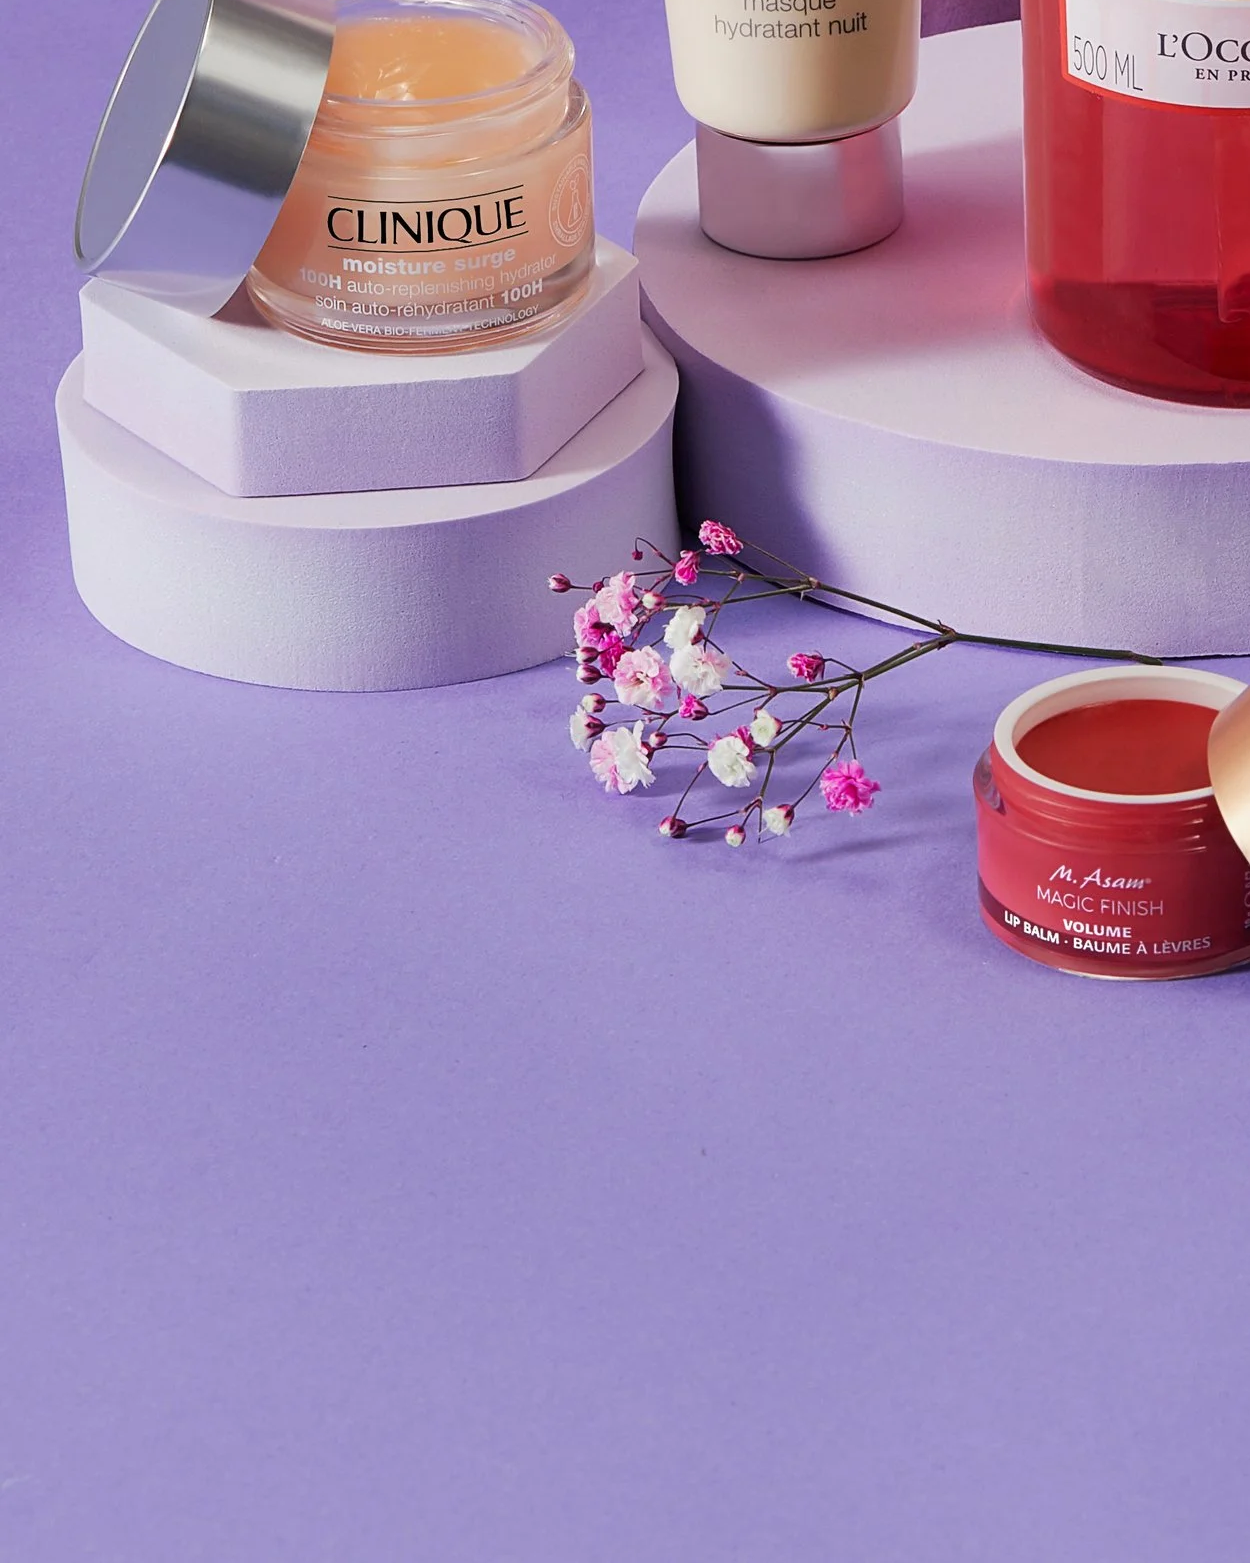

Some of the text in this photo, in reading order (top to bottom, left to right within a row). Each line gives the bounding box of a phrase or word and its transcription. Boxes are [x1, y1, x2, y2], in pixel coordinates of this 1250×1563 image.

[713, 11, 868, 40] hydratant nuit
[1073, 36, 1143, 92] 500 ML
[1195, 67, 1219, 80] EN
[327, 195, 526, 245] CLINIQUE
[300, 253, 557, 298] 100H auto-replenishing hydrator
[343, 247, 516, 275] moisture surge
[316, 278, 543, 320] soin auto-réhydratant 100H
[321, 318, 348, 330] ALOE
[352, 323, 381, 335] VERA
[468, 304, 539, 330] TECHNOLOGY
[1049, 865, 1077, 883] M.
[1037, 884, 1163, 915] MAGIC FINISH
[1004, 910, 1211, 955] LIP BALM BAUME À LÈVRES
[1063, 918, 1131, 938] VOLUME
